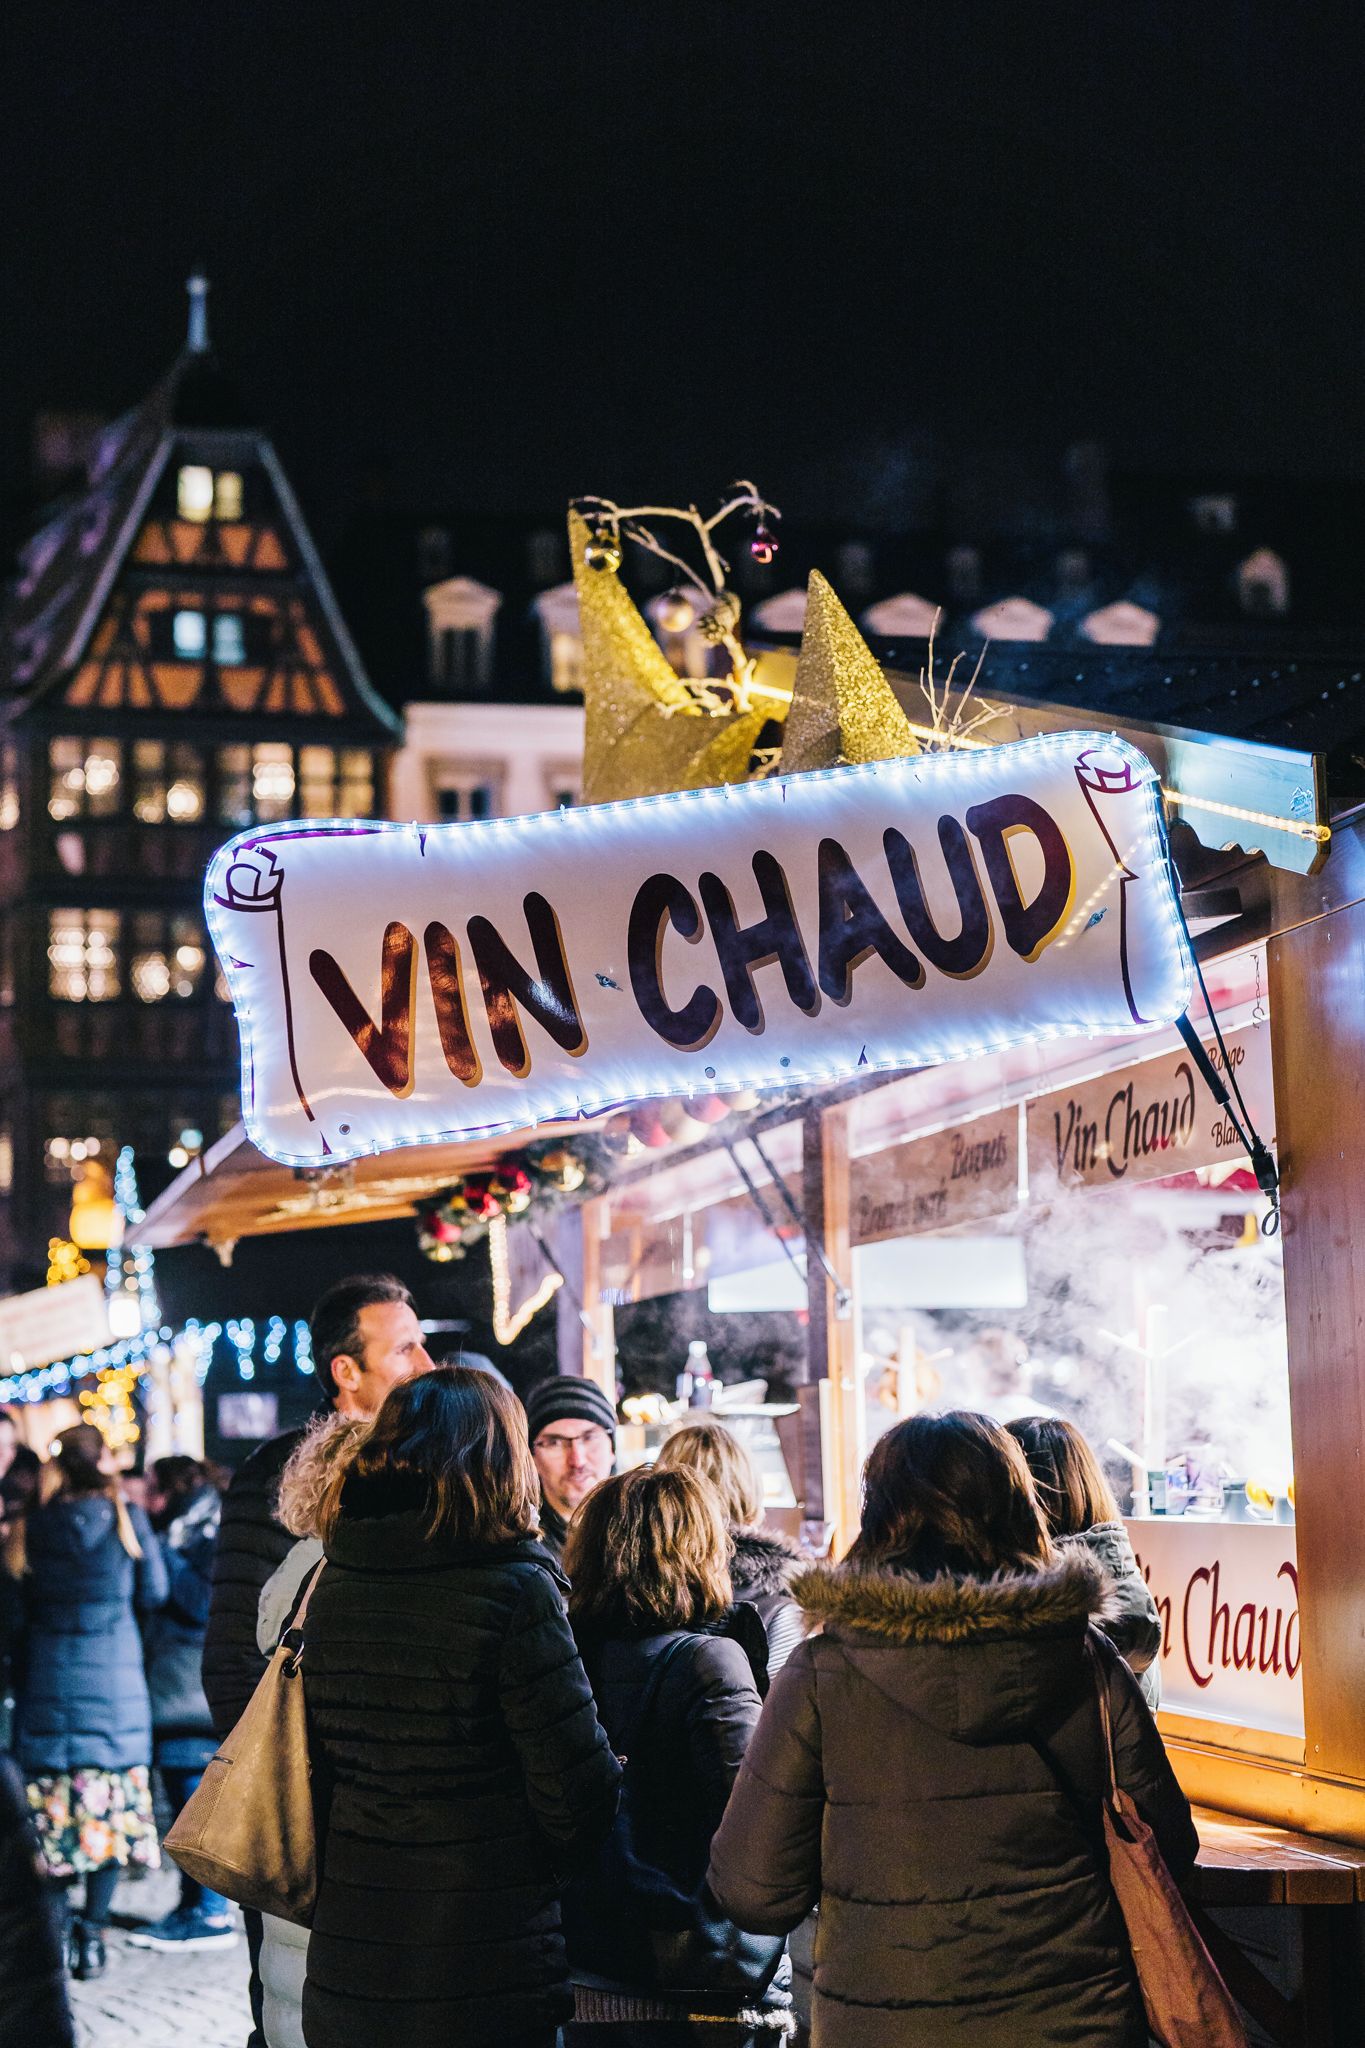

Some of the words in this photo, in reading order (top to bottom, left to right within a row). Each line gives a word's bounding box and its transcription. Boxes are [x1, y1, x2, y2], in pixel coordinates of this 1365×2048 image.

[309, 891, 588, 1098] VIN
[627, 794, 1076, 1053] CHAUD
[1054, 1099, 1098, 1179] Vin
[1105, 1061, 1196, 1178] Chaud
[1183, 1559, 1301, 1689] Chaud
